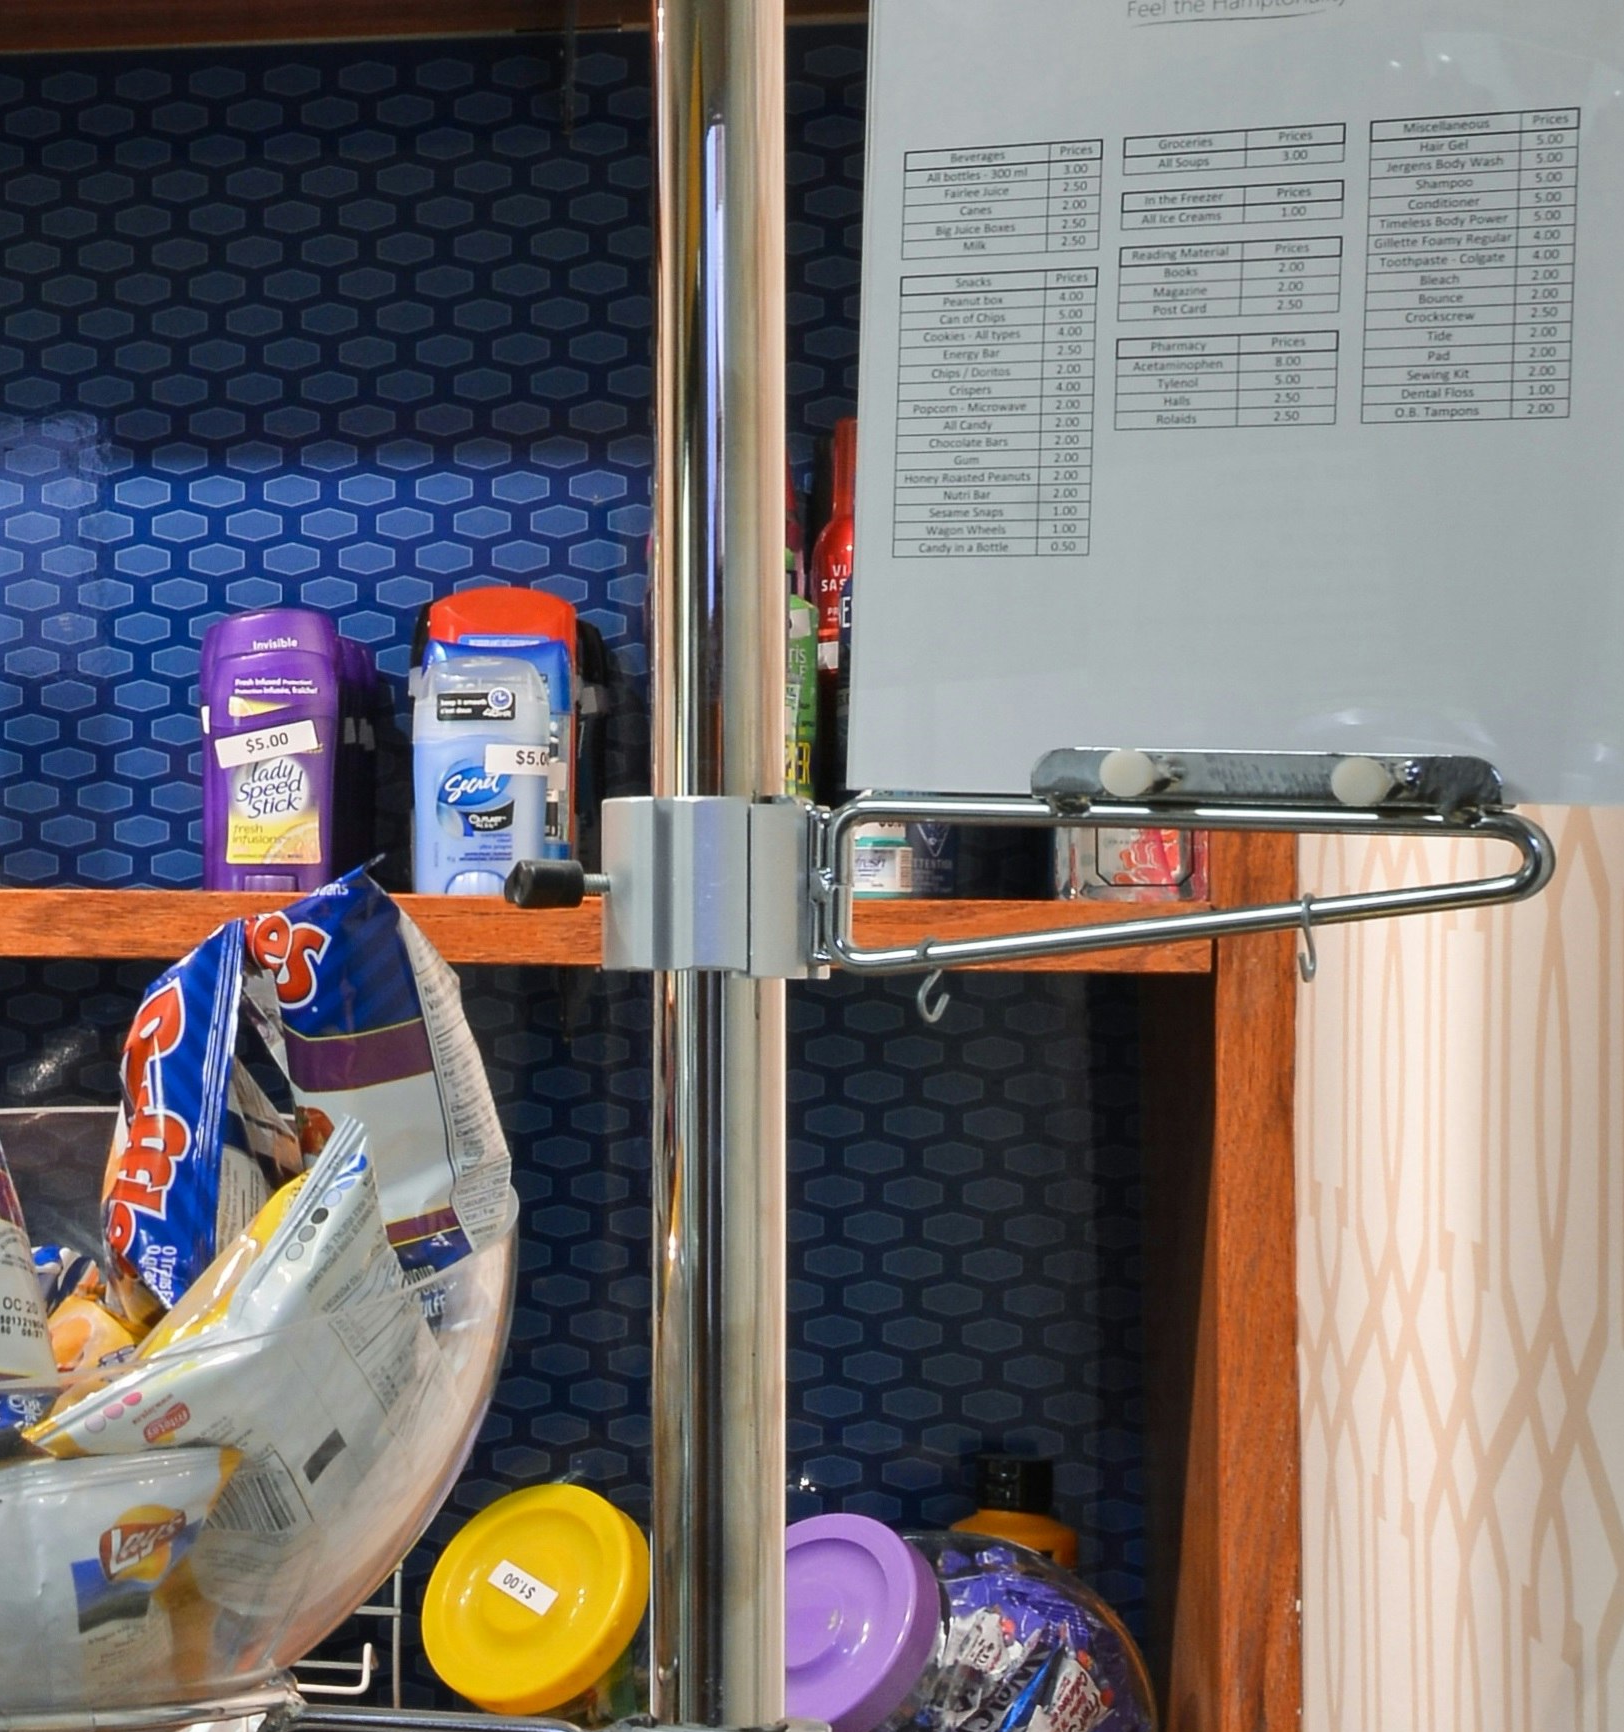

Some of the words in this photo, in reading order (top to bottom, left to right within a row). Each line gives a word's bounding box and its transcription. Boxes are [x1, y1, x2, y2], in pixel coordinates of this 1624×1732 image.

[1127, 1, 1166, 18] Feel
[1533, 114, 1569, 124] Prices
[1403, 120, 1490, 134] Miscellaneous
[1279, 131, 1313, 141] Prices
[1159, 138, 1213, 149] Groceries
[1060, 145, 1093, 155] Prices
[1283, 150, 1308, 161] 3.00
[950, 151, 1005, 163] Beverages
[1175, 157, 1210, 168] Soups
[1063, 164, 1088, 174] 3.00
[1387, 160, 1432, 174] Jergens
[1436, 158, 1466, 170] Body
[1470, 156, 1504, 167] Wash
[944, 171, 980, 181] bottles
[1535, 171, 1562, 183] 5.00
[1063, 181, 1087, 191] 2.50
[1415, 178, 1473, 190] Shampoo
[983, 188, 1009, 196] Juice
[1062, 200, 1087, 210] 2.00
[954, 224, 981, 235] Juice
[984, 223, 1015, 232] Boxes
[963, 241, 986, 250] Milk
[1380, 255, 1448, 268] Toothpaste
[1460, 252, 1505, 265] Colgate
[955, 277, 991, 287] Snacks
[1056, 273, 1088, 283] Prices
[1153, 286, 1207, 299] Magazine
[940, 315, 959, 324] Can
[976, 312, 1005, 323] Chips
[1058, 309, 1083, 319] 5.00
[1151, 341, 1206, 352] Pharmacy
[1271, 336, 1306, 347] Prices
[943, 349, 979, 361] Energy
[983, 349, 1000, 358] Bar
[1133, 360, 1223, 372] Acetaminophen
[1275, 356, 1301, 366] 8.00
[1275, 374, 1300, 385] 5.00
[1407, 370, 1450, 381] Sewing
[1158, 378, 1198, 390] Tylenol
[1402, 388, 1441, 399] Dental
[1444, 388, 1474, 398] Floss
[1529, 385, 1555, 395] 1.00
[913, 404, 957, 415] Popcorn
[968, 402, 1026, 412] Microwave
[1156, 414, 1197, 424] Rolaids
[1274, 410, 1299, 421] 2.50
[905, 474, 939, 485] Honey
[942, 473, 985, 482] Roasted
[988, 472, 1031, 481] Peanuts
[1053, 470, 1078, 480] 2.00
[926, 526, 964, 537] Wagon
[966, 525, 1006, 535] Wheels
[1052, 524, 1076, 533] 1.00
[253, 637, 297, 650] Invisible
[246, 733, 289, 753] $5.00
[445, 775, 501, 801] Secret
[501, 1571, 537, 1603] $1.00
